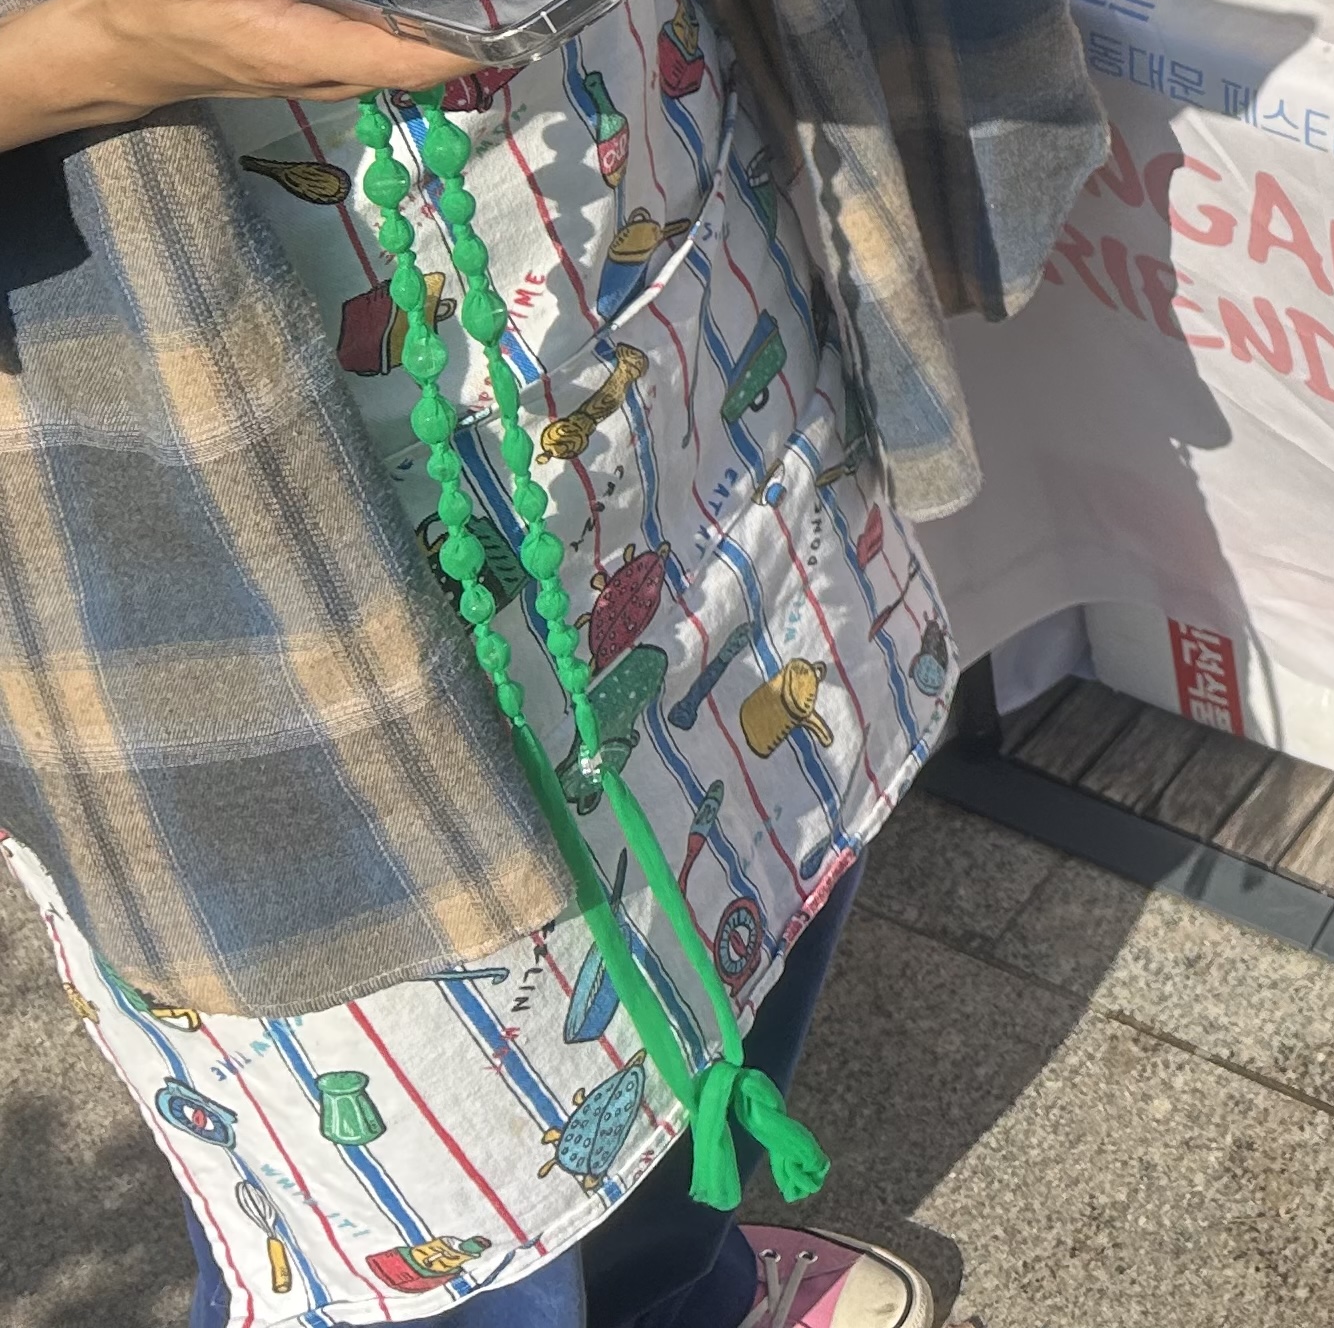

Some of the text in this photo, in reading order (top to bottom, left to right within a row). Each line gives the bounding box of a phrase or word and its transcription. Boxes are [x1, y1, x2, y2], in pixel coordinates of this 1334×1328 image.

[1087, 31, 1206, 109] 동대문
[707, 466, 739, 518] EAT
[807, 501, 823, 567] DONE
